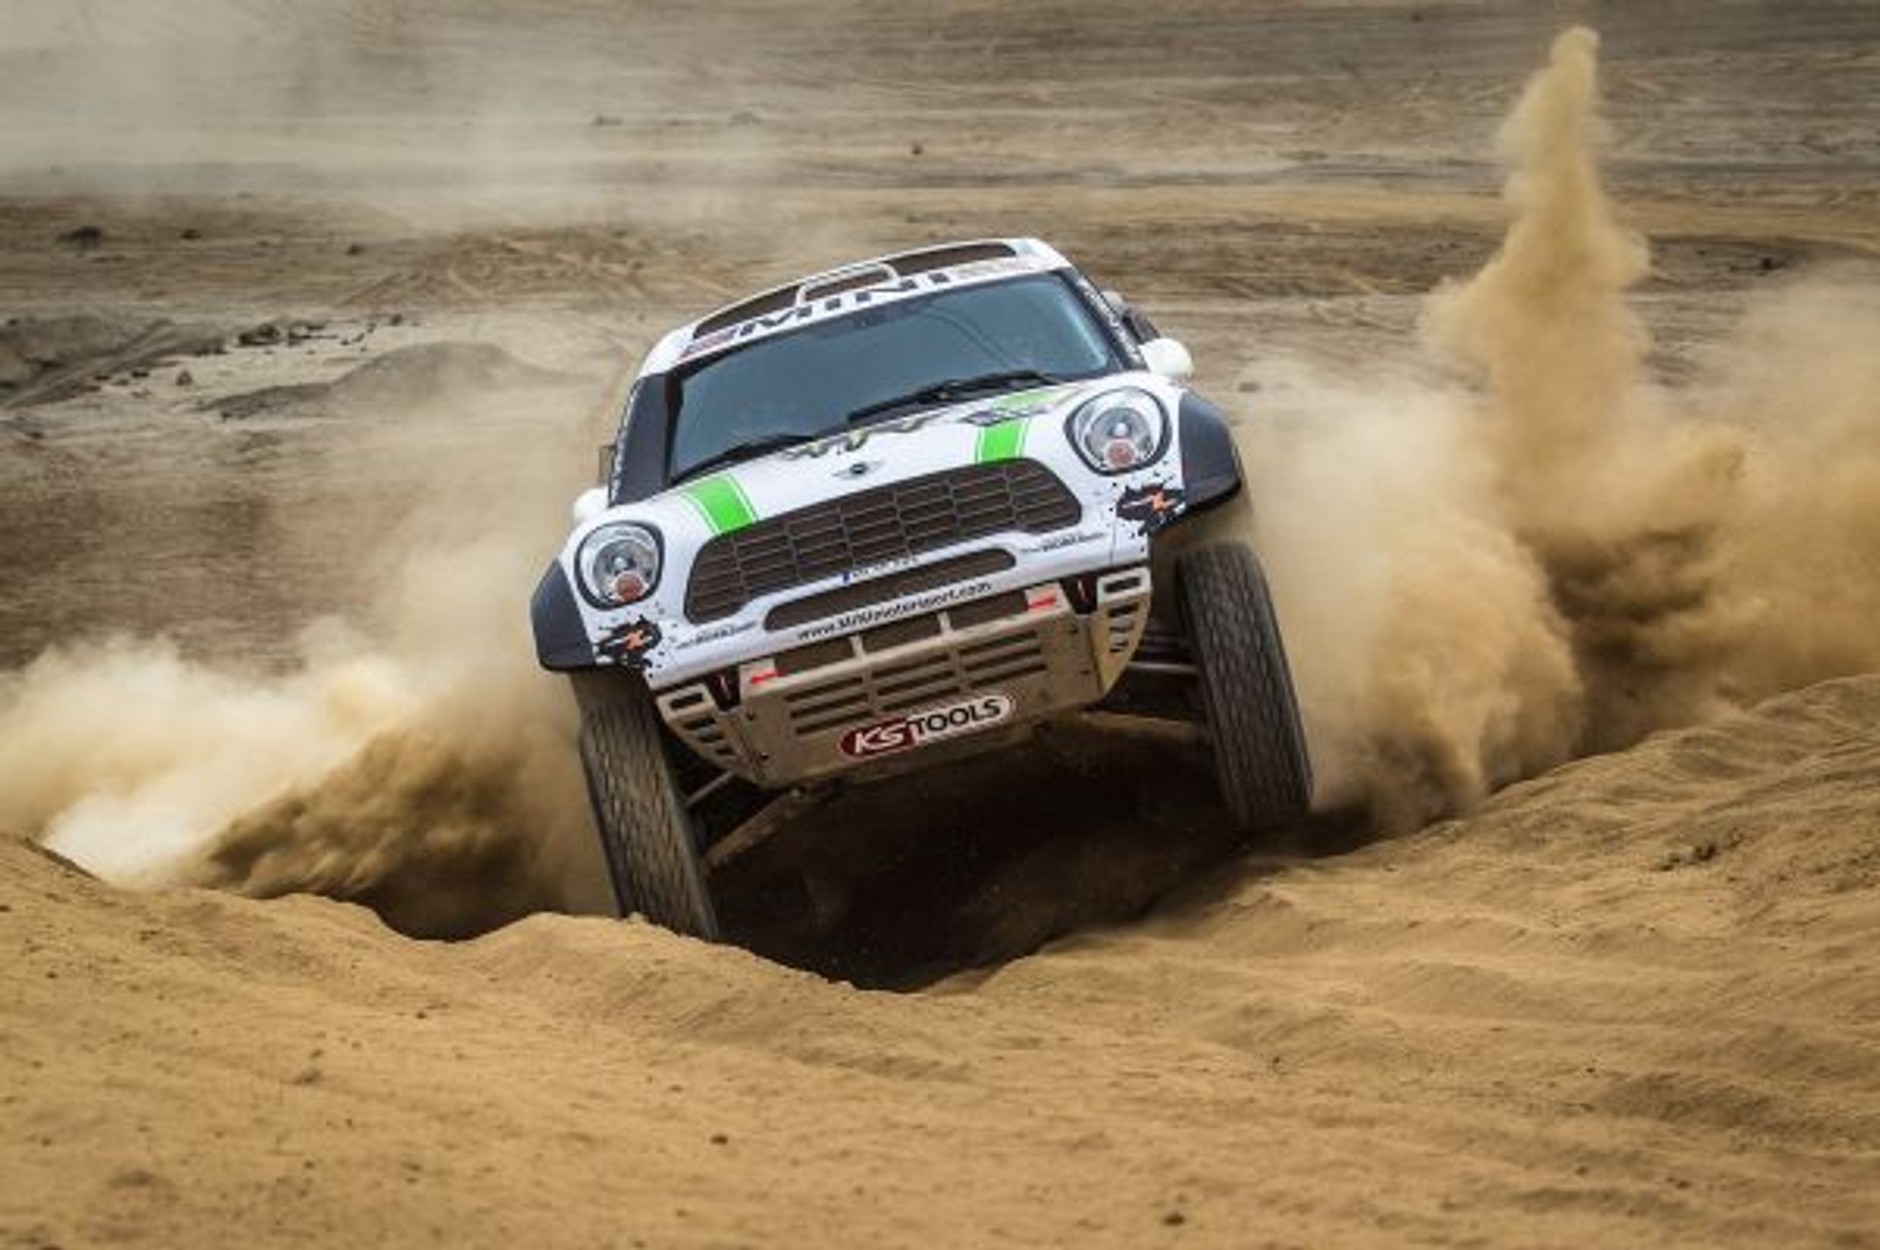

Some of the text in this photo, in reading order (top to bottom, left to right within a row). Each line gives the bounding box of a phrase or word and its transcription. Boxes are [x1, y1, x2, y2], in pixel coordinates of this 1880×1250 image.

[740, 271, 950, 337] MINI
[855, 698, 1001, 754] KS TOOLS
